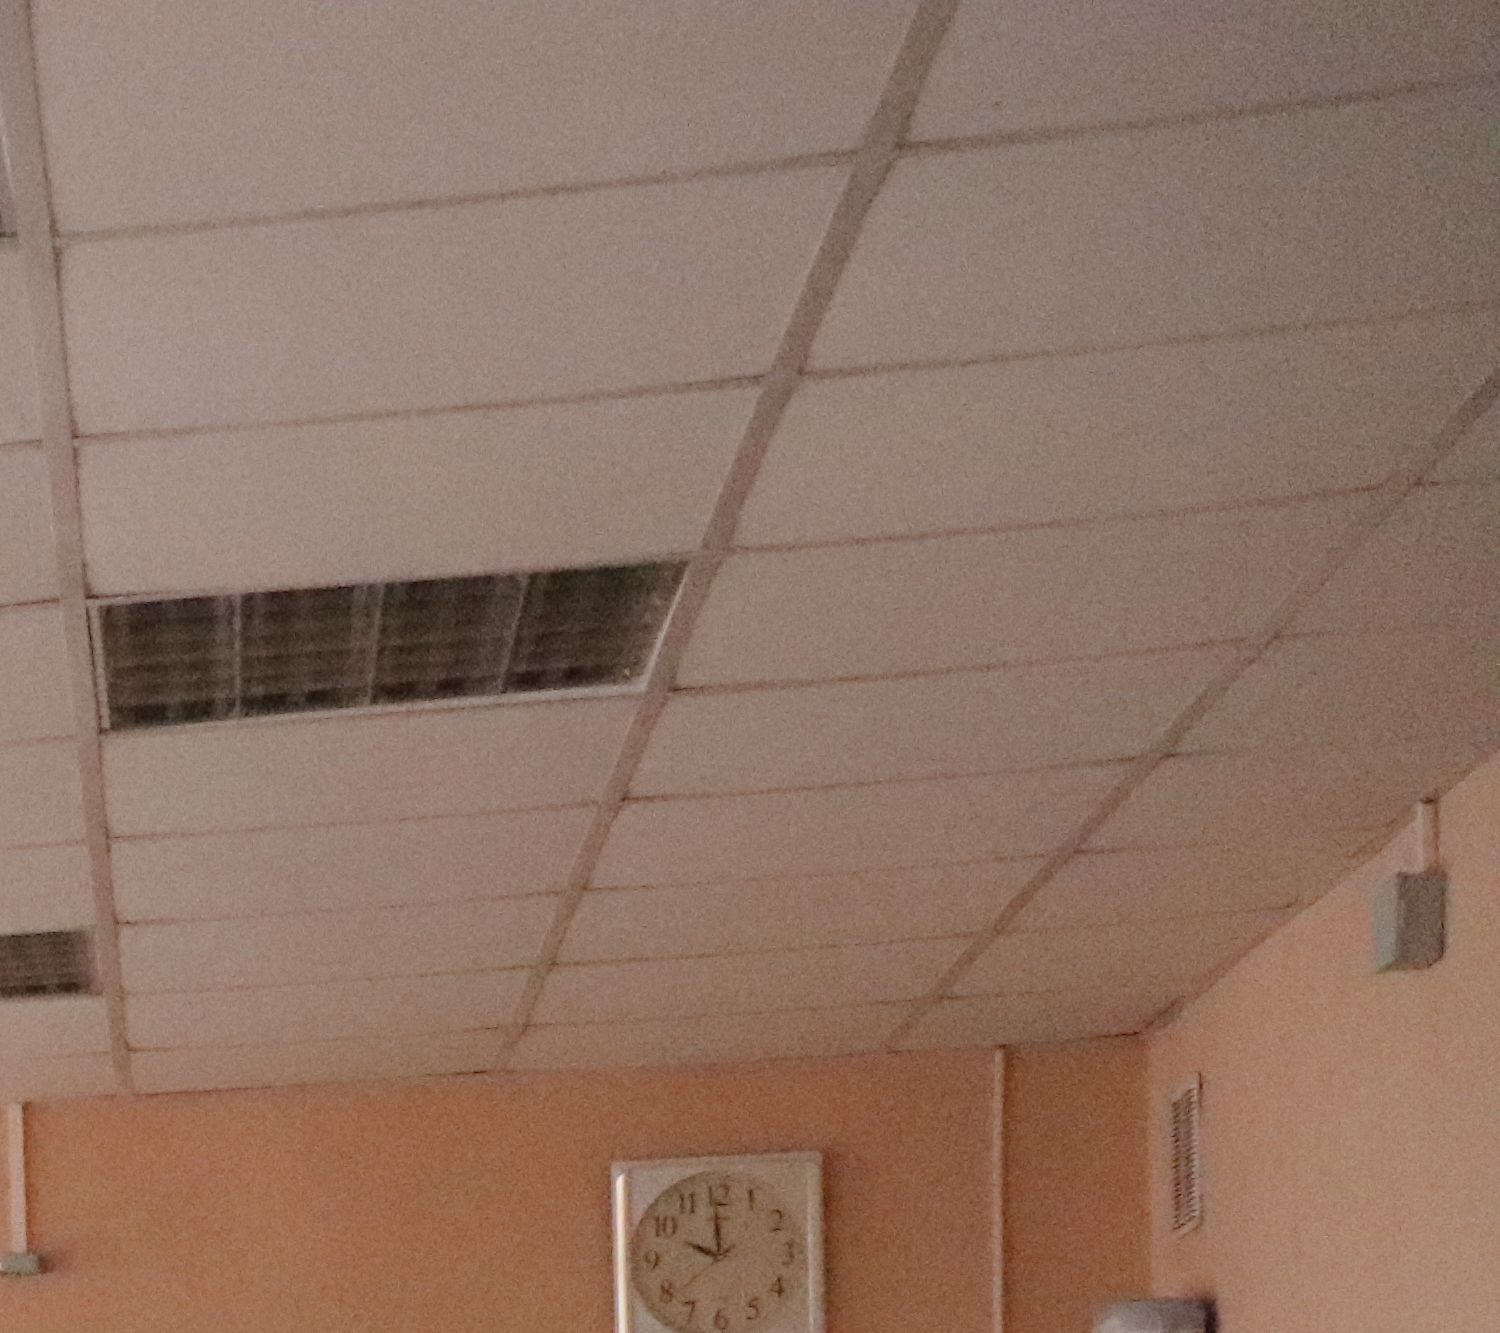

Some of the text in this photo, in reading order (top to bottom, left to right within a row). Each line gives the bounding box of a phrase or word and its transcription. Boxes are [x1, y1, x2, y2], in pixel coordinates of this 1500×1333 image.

[678, 1193, 697, 1215] 11
[708, 1184, 730, 1207] 12
[746, 1189, 756, 1211] 1
[653, 1216, 678, 1238] 10
[770, 1209, 784, 1232] 2
[643, 1251, 660, 1271] 9
[780, 1241, 794, 1265] 3
[660, 1281, 674, 1303] 8
[767, 1275, 785, 1298] 4
[681, 1301, 696, 1324] 7
[712, 1309, 729, 1331] 6
[746, 1298, 760, 1320] 5
